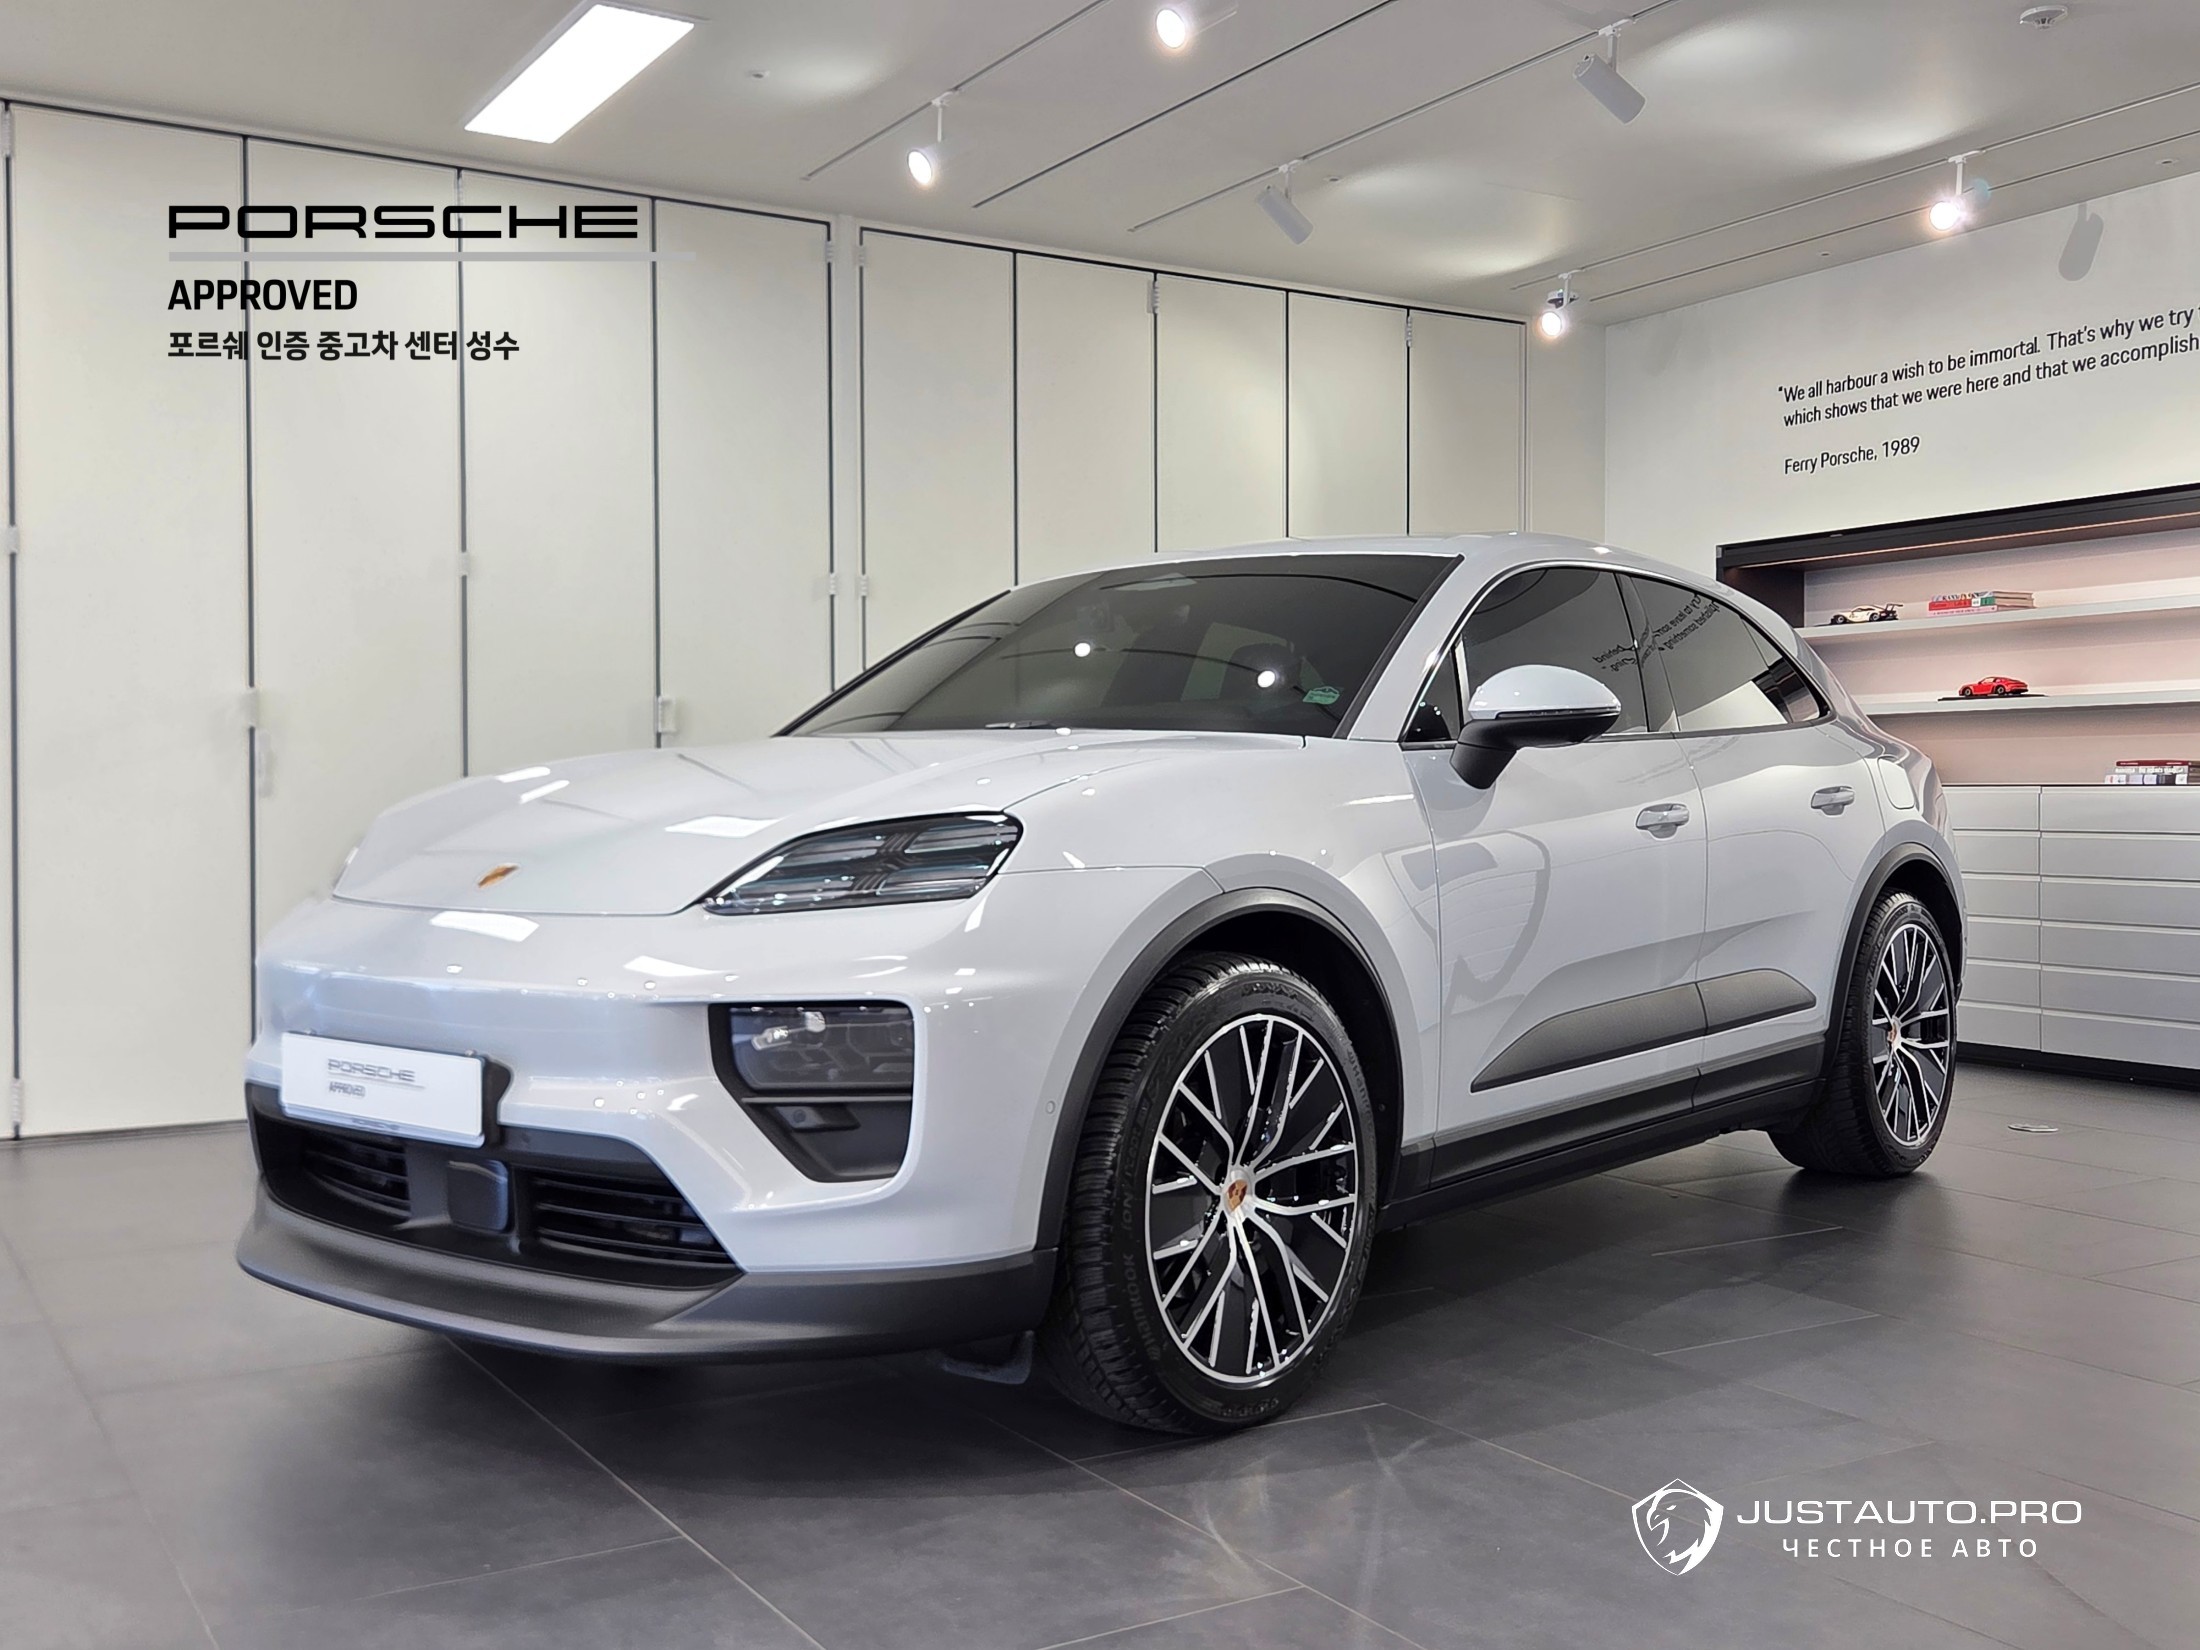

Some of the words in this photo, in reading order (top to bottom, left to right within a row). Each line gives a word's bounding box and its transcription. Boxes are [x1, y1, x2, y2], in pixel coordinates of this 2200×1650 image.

[1783, 406, 1821, 427] which
[1825, 401, 1867, 420] shows
[1871, 393, 1899, 411] that
[1902, 390, 1923, 405] we
[1926, 383, 1962, 401] were
[1966, 376, 1999, 394] here
[2003, 365, 2031, 387] and
[2036, 359, 2069, 380] that
[2073, 356, 2097, 373] we
[2100, 333, 2199, 367] accomplish
[1808, 381, 1822, 398] all
[1826, 374, 1878, 395] harbour
[1880, 371, 1888, 384] a
[1892, 361, 1924, 381] wish
[1928, 359, 1943, 374] to
[1947, 355, 1966, 371] be
[1969, 336, 2041, 367] immortal.
[2047, 326, 2096, 351] That's
[2100, 319, 2134, 340] why
[2138, 314, 2164, 332] we
[2168, 308, 2194, 328] try
[1785, 457, 1818, 475] Ferry
[1821, 446, 1878, 468] Porsche,
[1882, 436, 1920, 458] 1989
[327, 1058, 416, 1082] PORSCHE
